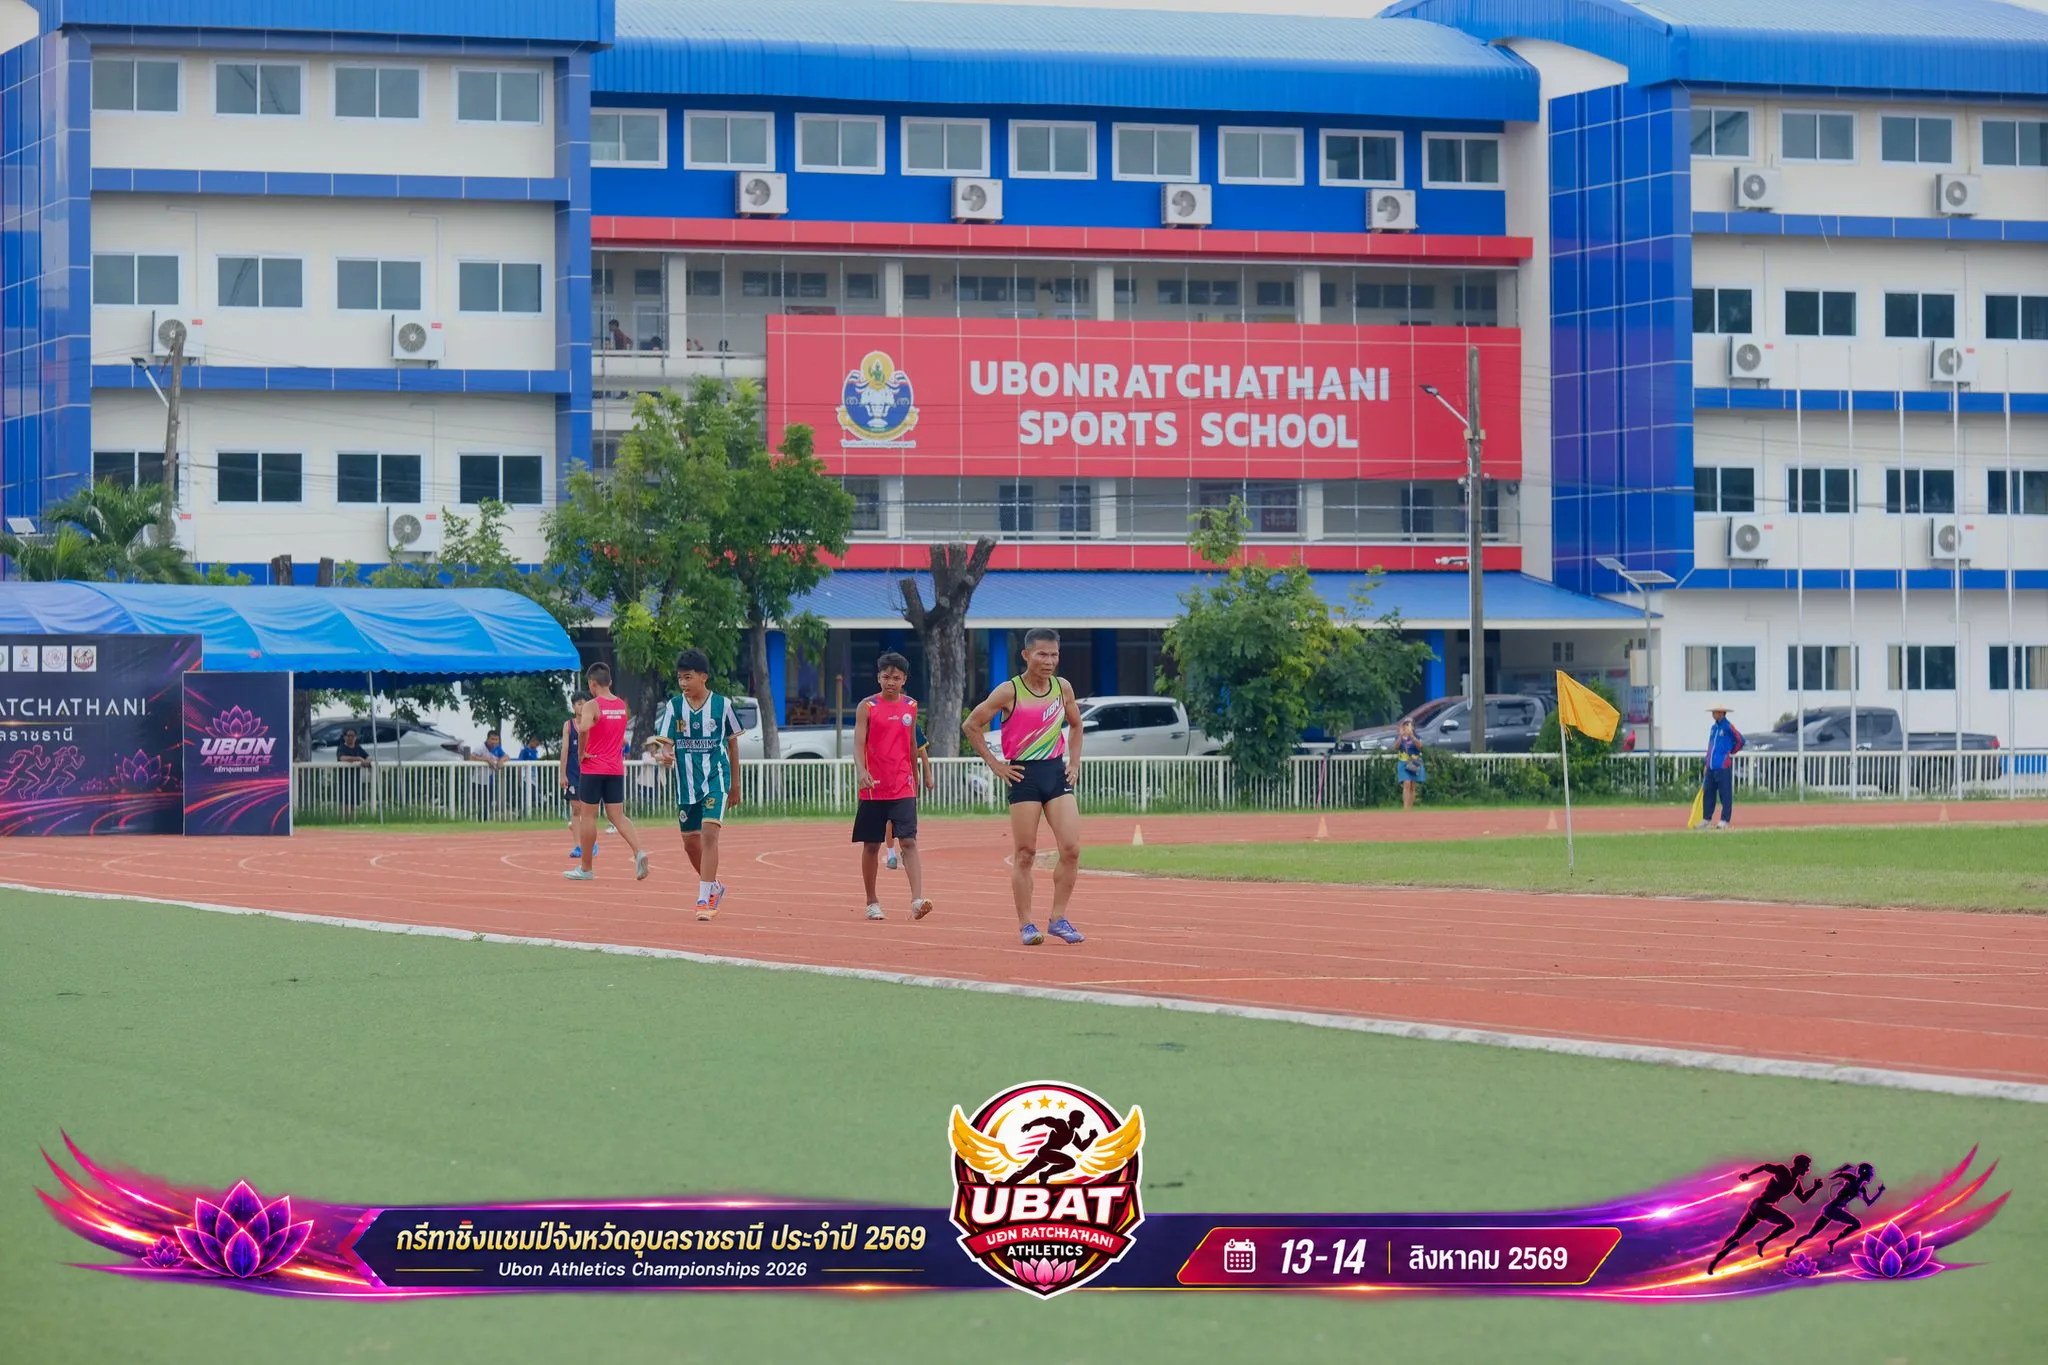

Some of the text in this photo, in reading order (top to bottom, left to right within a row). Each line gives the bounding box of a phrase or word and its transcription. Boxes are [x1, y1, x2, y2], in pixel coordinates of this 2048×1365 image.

[969, 360, 1390, 402] UBONRATCHATHANI
[1018, 410, 1359, 450] SPORTS SCHOOL
[200, 737, 277, 756] UBON
[202, 755, 273, 766] ATHLETICS
